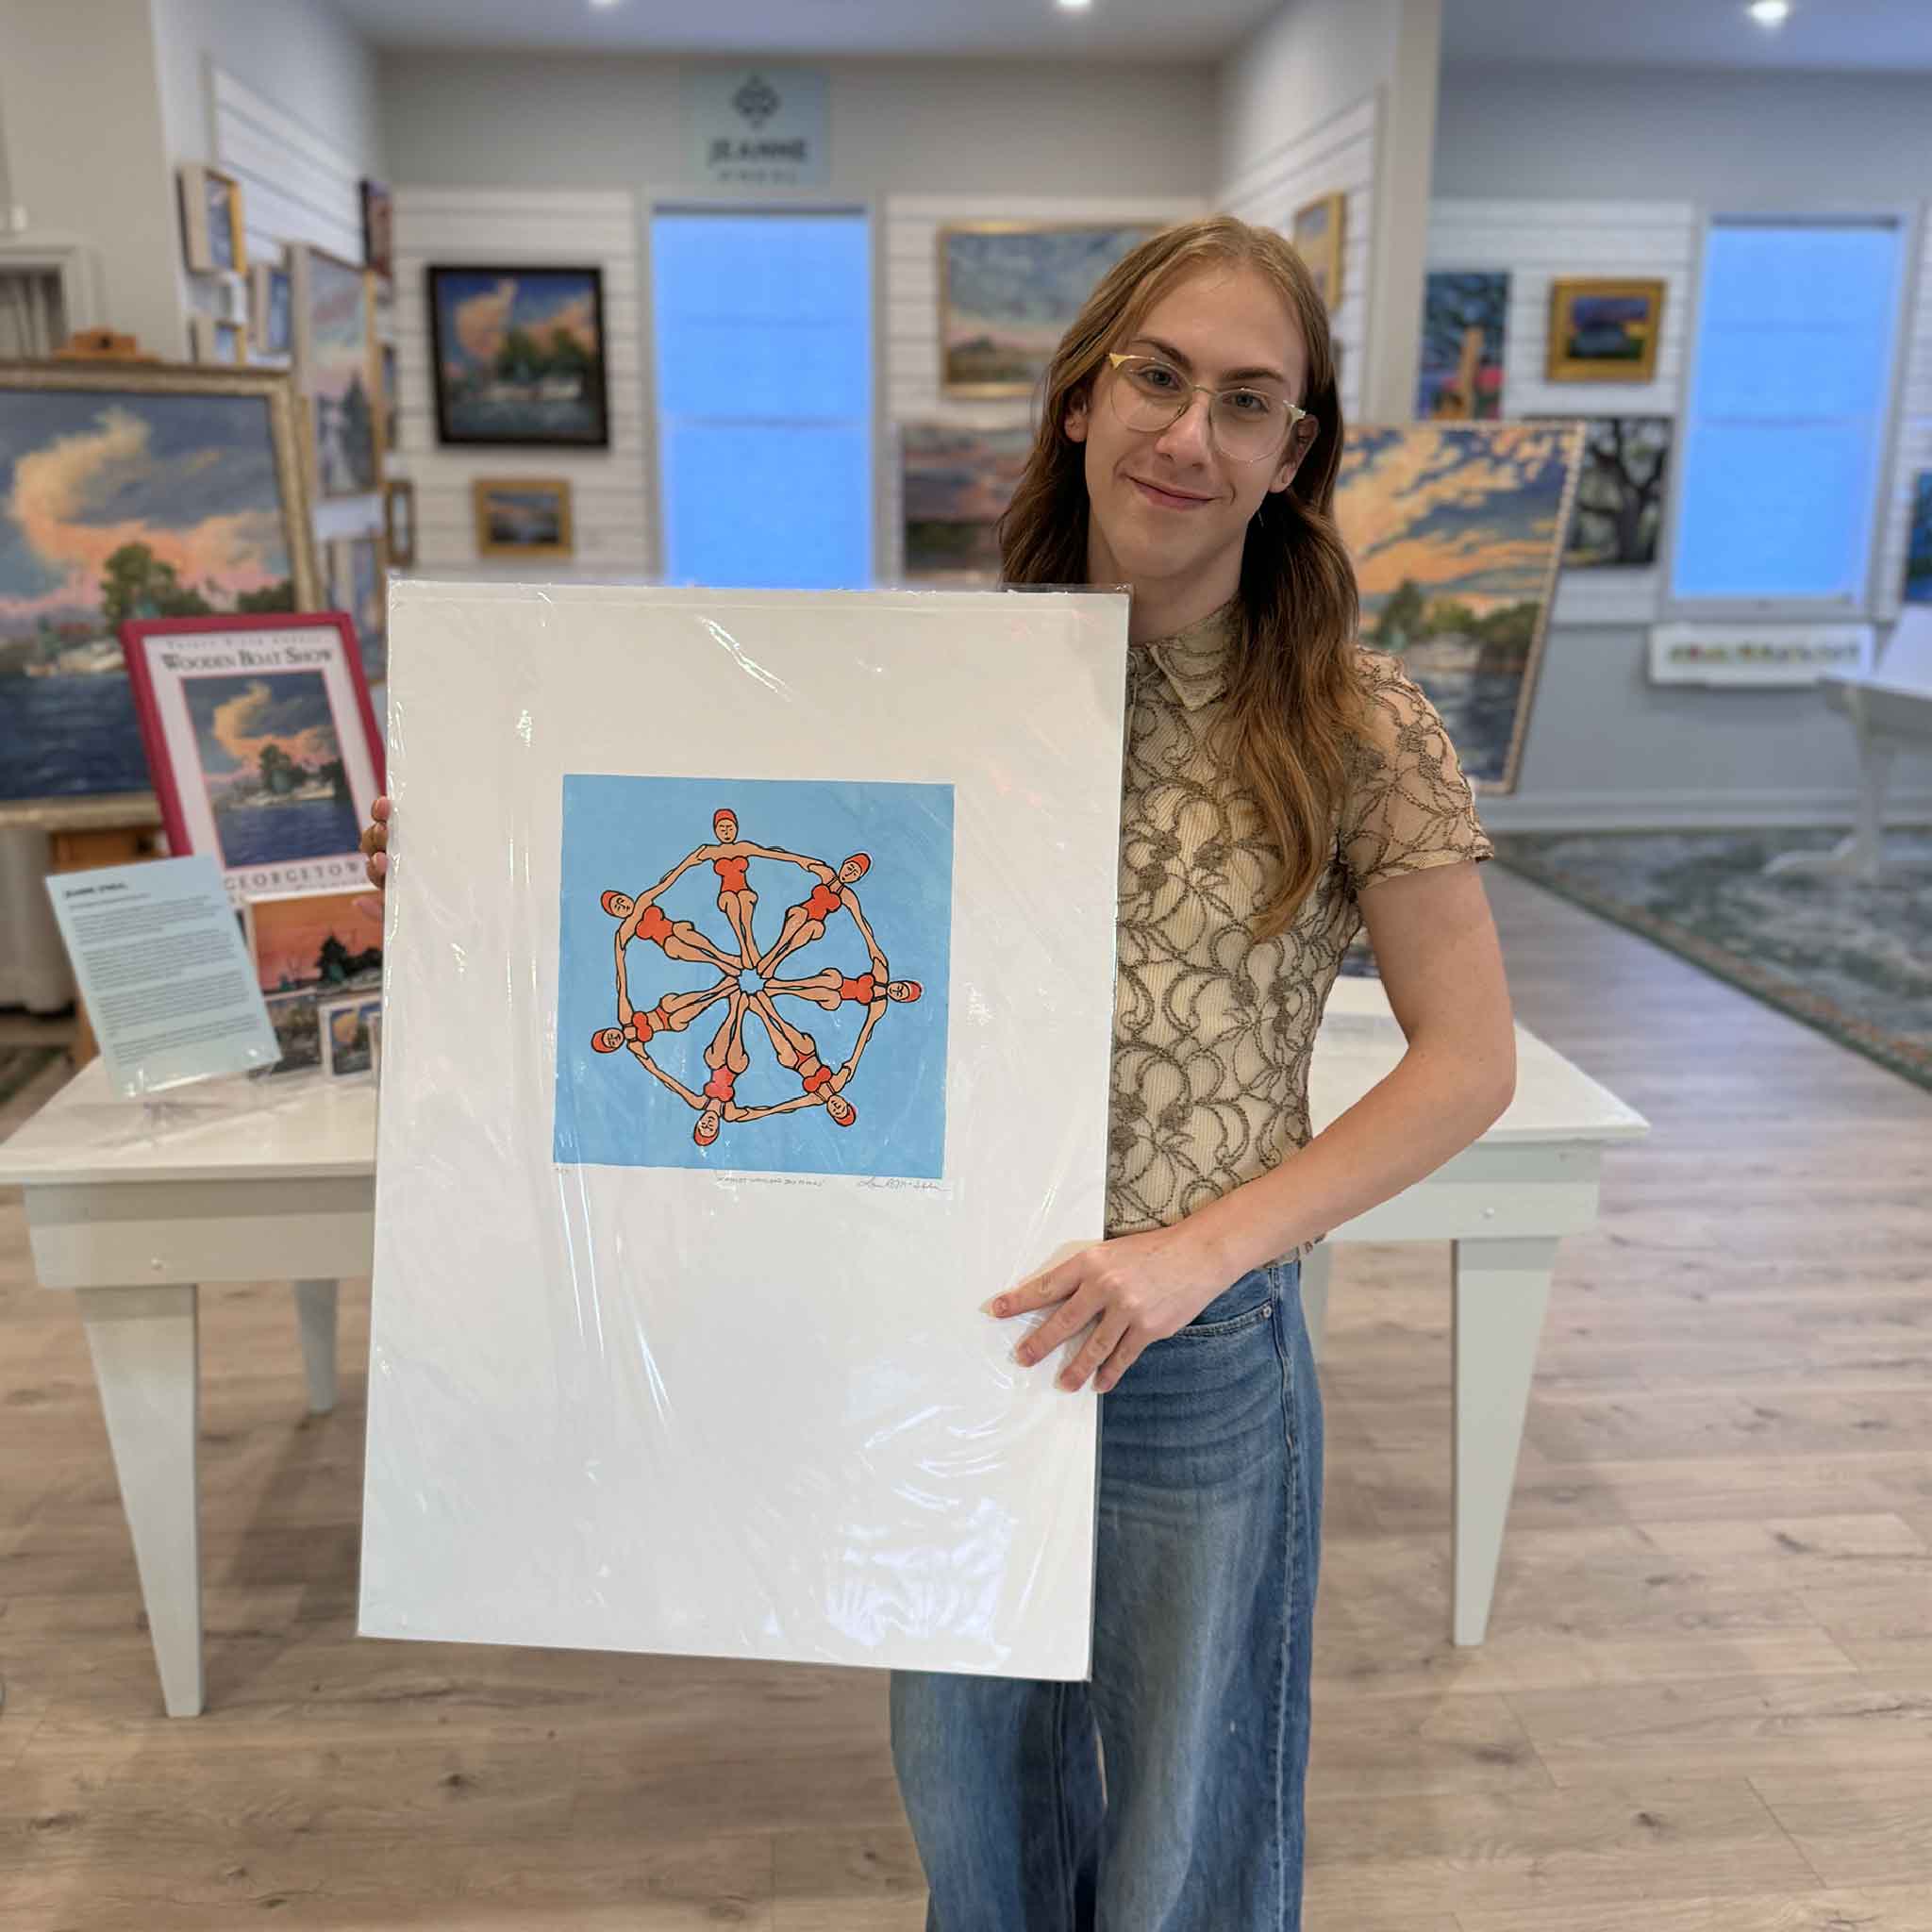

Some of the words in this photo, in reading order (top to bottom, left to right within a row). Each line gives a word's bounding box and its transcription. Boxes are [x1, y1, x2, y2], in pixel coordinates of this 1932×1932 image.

[161, 653, 236, 670] WOODEN
[239, 649, 282, 666] BOAT
[285, 646, 331, 664] SHOW
[224, 861, 359, 891] GEORGETOW
